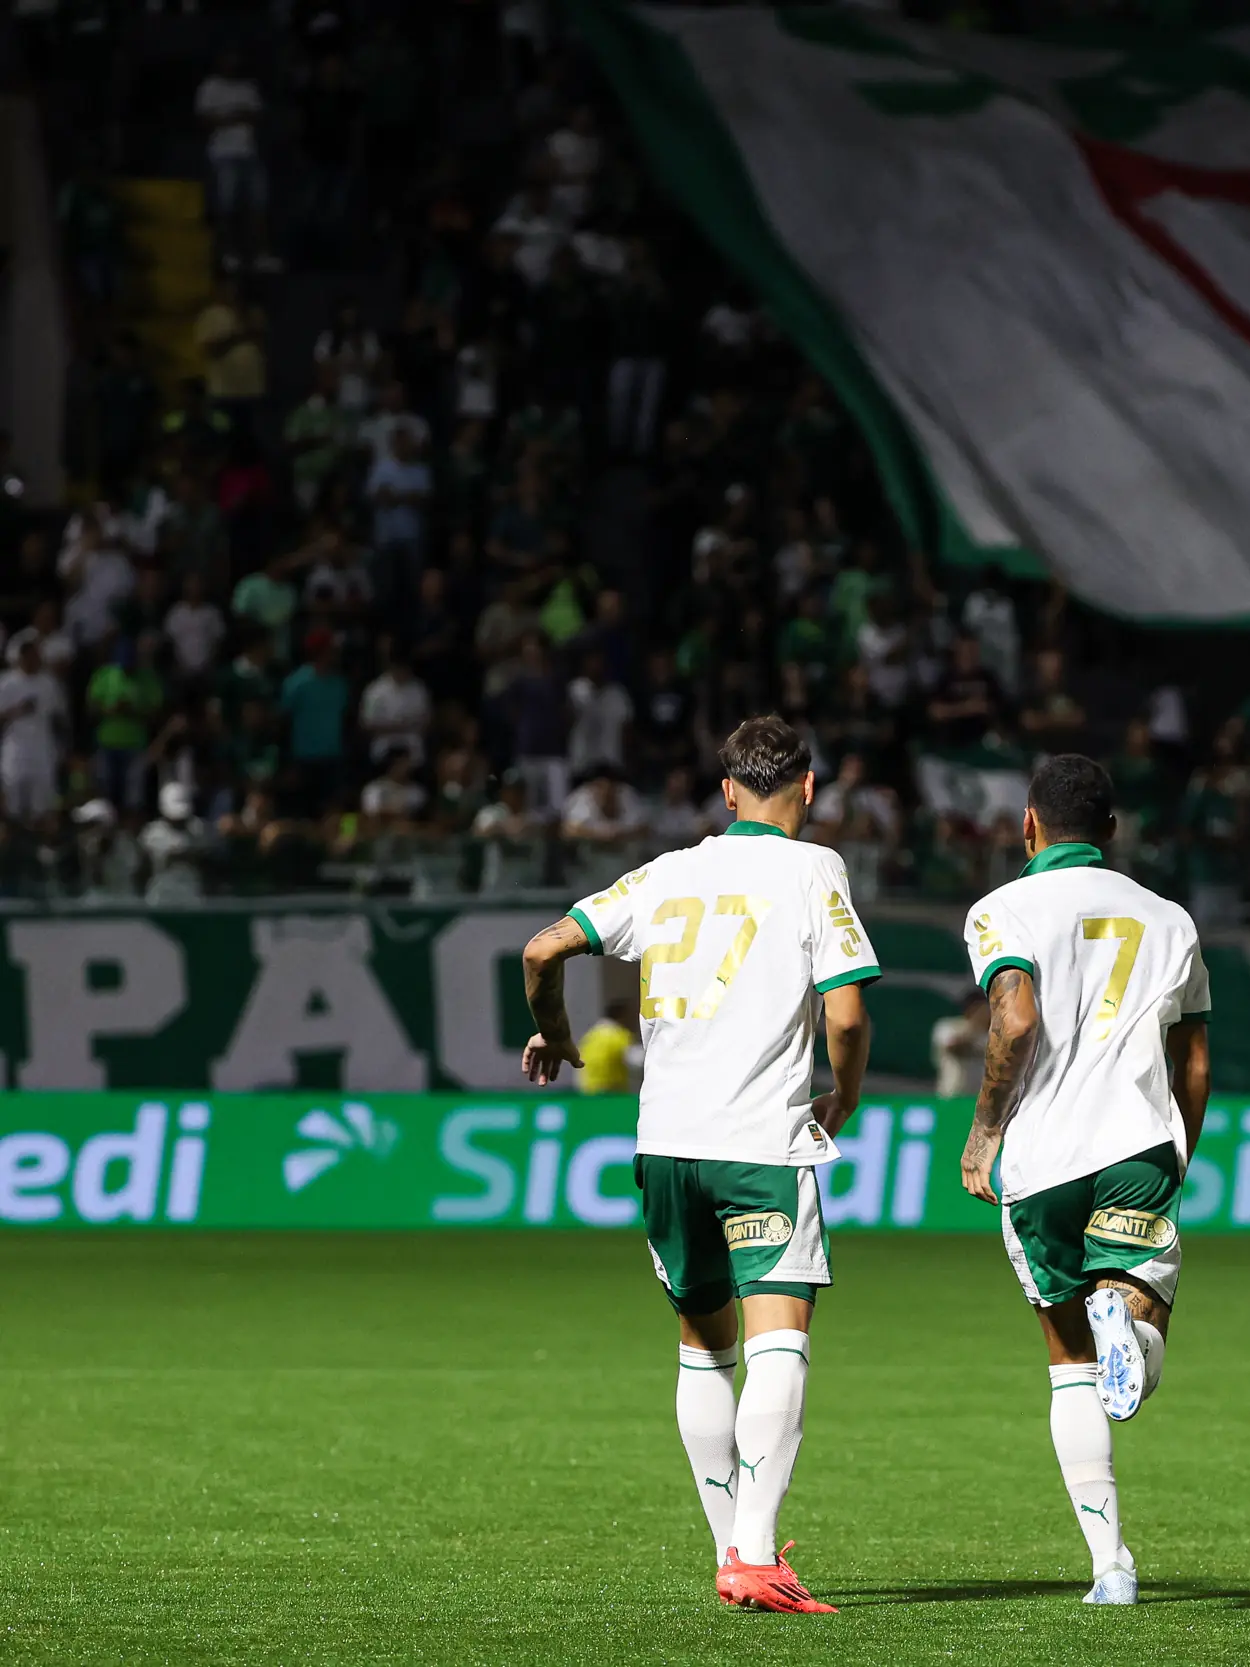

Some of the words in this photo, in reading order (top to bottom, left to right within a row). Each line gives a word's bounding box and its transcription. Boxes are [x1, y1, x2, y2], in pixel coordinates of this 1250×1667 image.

[640, 894, 772, 1020] 27
[1081, 917, 1146, 1042] 7
[431, 1105, 935, 1225] Sicdi
[1093, 1212, 1148, 1237] AVANTI
[727, 1221, 761, 1244] VANTI
